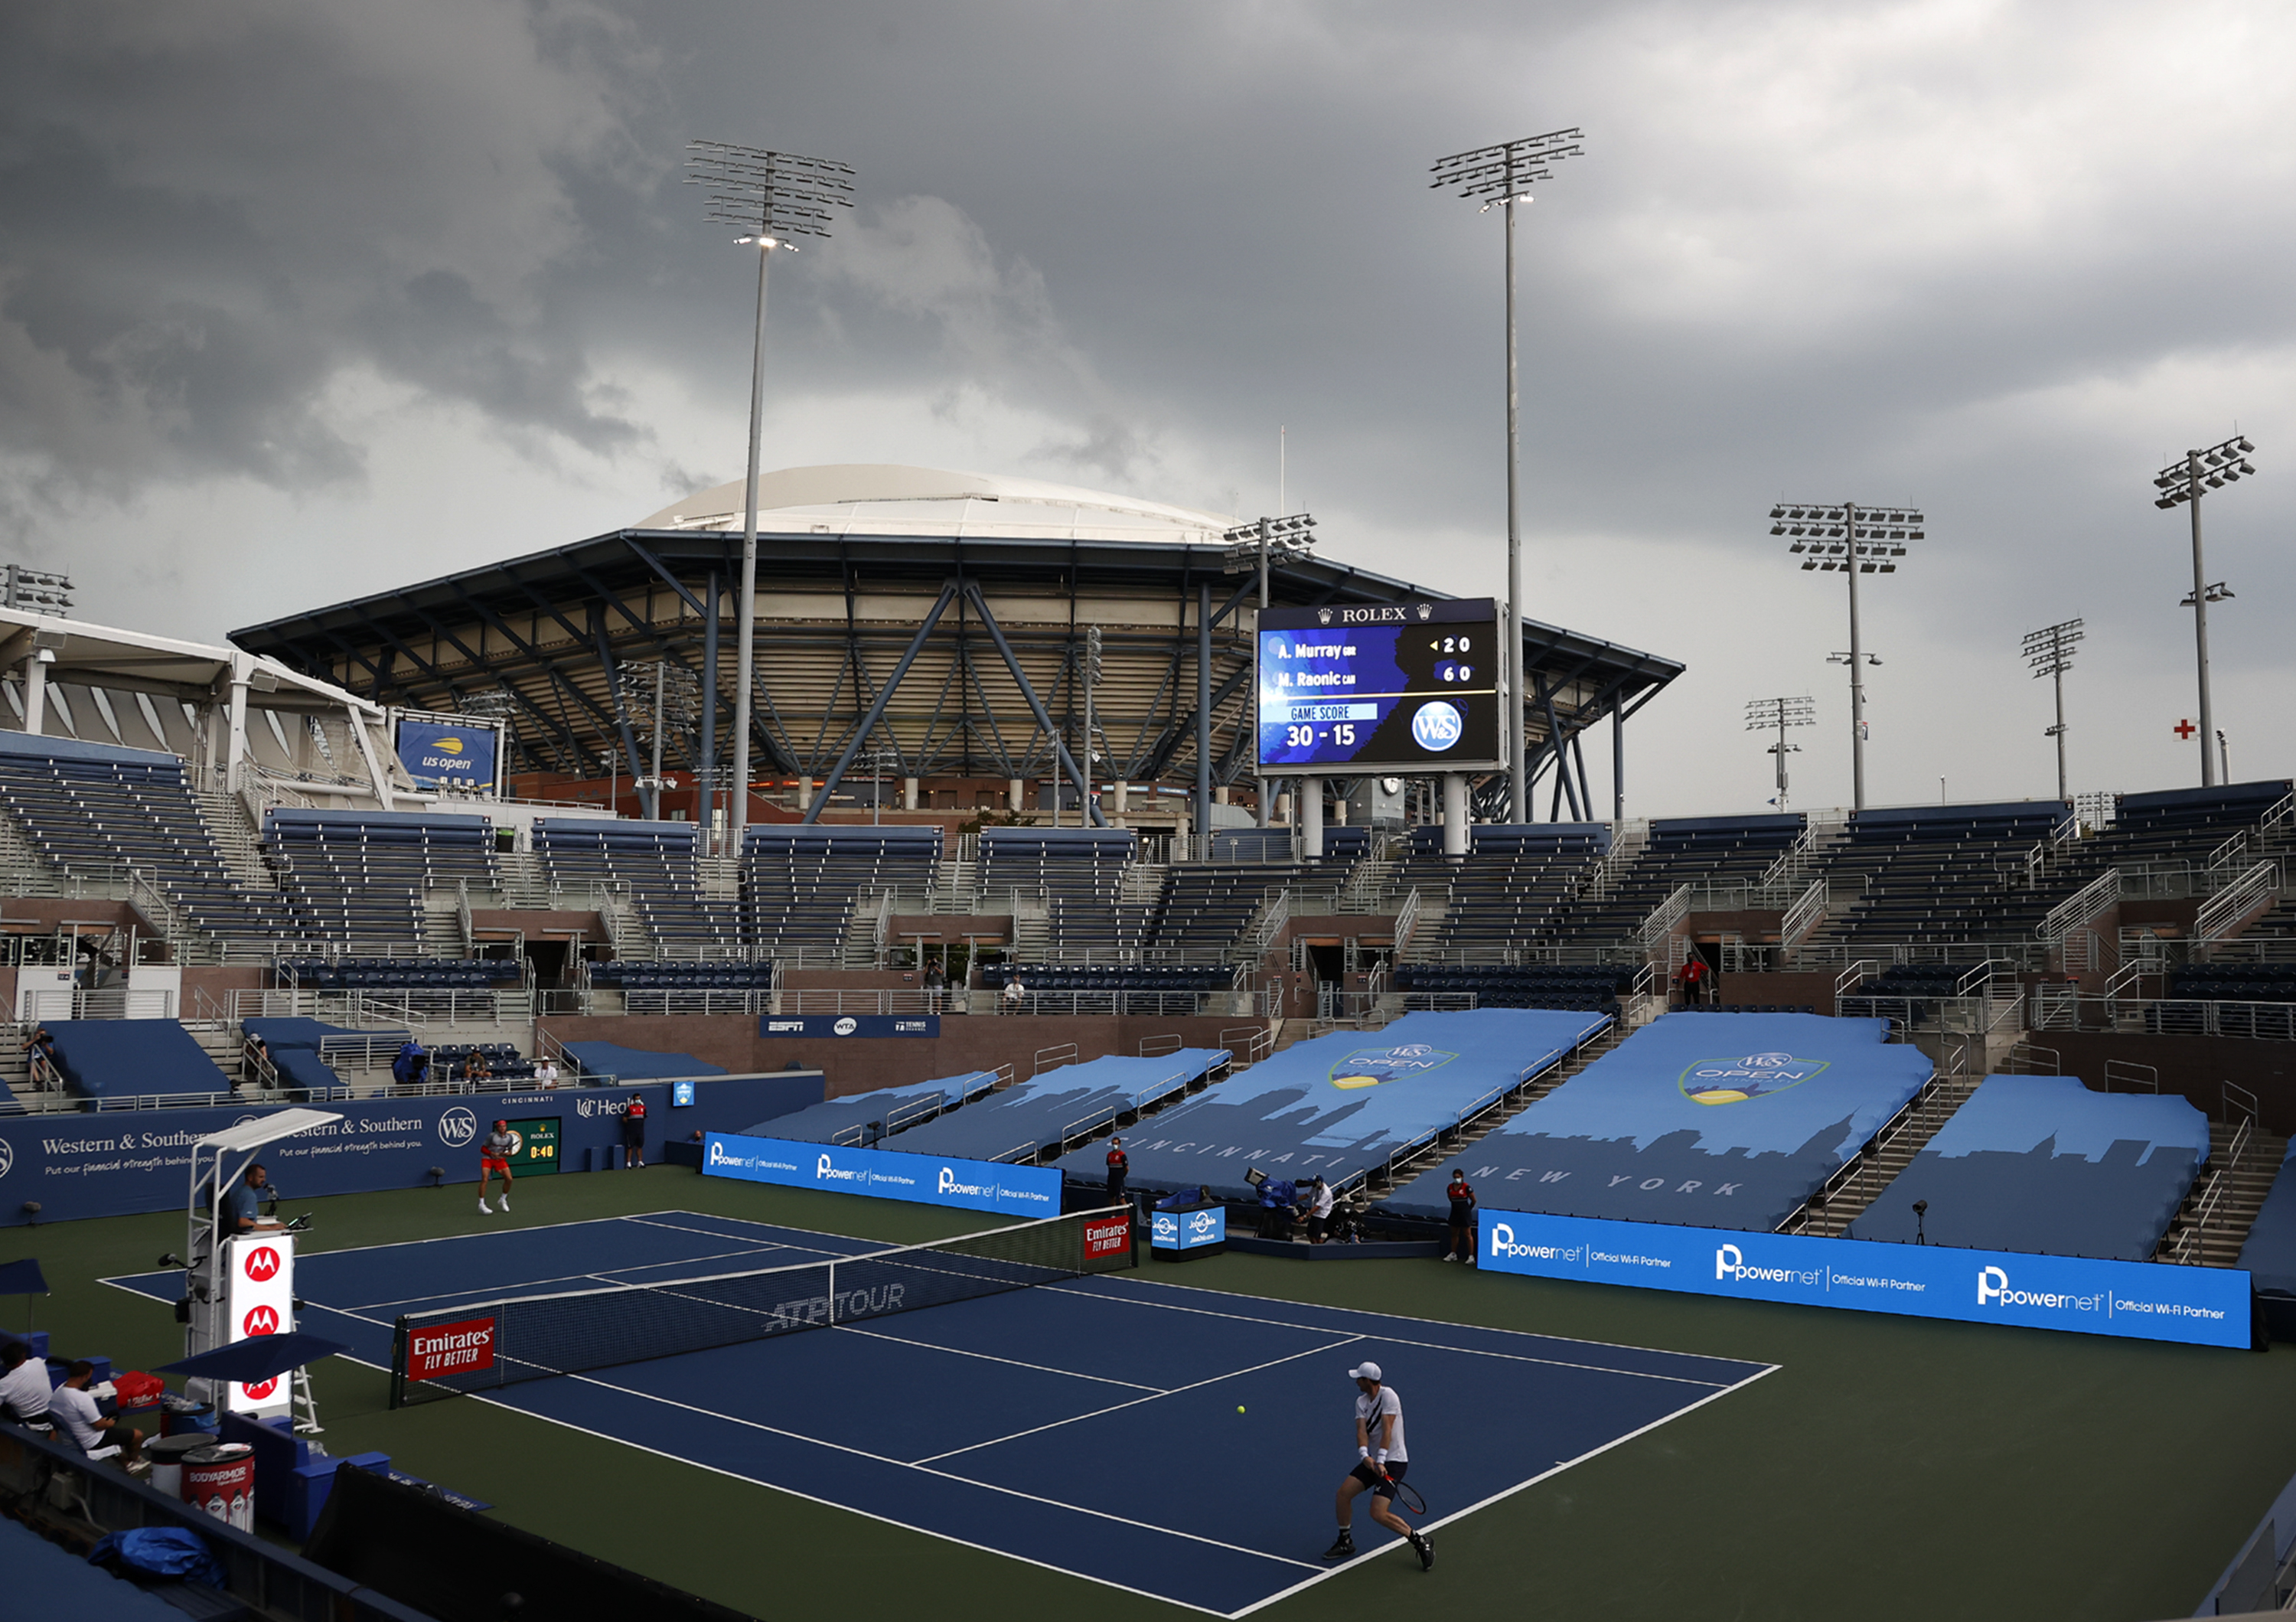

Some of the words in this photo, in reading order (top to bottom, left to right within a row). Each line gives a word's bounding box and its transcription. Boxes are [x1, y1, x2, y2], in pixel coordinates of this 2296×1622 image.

[1342, 608, 1407, 622] ROLEX
[1278, 645, 1292, 659] A.
[1295, 643, 1342, 660] Murray
[1443, 638, 1455, 653] 2
[1297, 671, 1342, 686] Raonic
[1443, 667, 1455, 682] 6
[1290, 707, 1316, 721] GAME
[1320, 706, 1350, 720] SCORE
[1287, 726, 1313, 746] 30
[1333, 724, 1356, 746] 15
[1417, 715, 1456, 740] W&S
[439, 758, 472, 771] open
[768, 1021, 804, 1031] ESPN
[1349, 1058, 1434, 1069] OPEN
[1695, 1069, 1805, 1079] OPEN
[502, 1096, 554, 1105] CINCINNATI
[598, 1096, 644, 1116] Heal
[285, 1123, 338, 1138] stern
[341, 1119, 355, 1134] &
[360, 1118, 422, 1133] Southern
[442, 1117, 473, 1138] W&S
[42, 1138, 115, 1154] Western
[119, 1134, 136, 1149] &
[142, 1130, 211, 1148] Southe
[311, 1144, 342, 1158] financial
[344, 1141, 378, 1155] strength
[380, 1141, 406, 1150] behind
[530, 1145, 553, 1158] 0:40
[1107, 1137, 1345, 1168] CINCINNATI
[45, 1165, 61, 1175] Put
[64, 1165, 80, 1173] our
[83, 1159, 120, 1176] financial
[123, 1156, 163, 1172] strength
[1471, 1166, 1572, 1183] NEW
[1607, 1175, 1743, 1196] YORK
[1000, 1189, 1017, 1198] Official
[1031, 1193, 1049, 1202] Partner
[1087, 1225, 1127, 1242] Emirates
[1093, 1241, 1102, 1252] FLY
[1103, 1237, 1121, 1251] BETTER
[1591, 1252, 1619, 1263] Official
[1621, 1255, 1639, 1265] Wi-Fi
[1641, 1256, 1671, 1268] Partner
[1832, 1274, 1864, 1287] Official
[1867, 1278, 1888, 1288] Wi-Fi
[1890, 1279, 1926, 1292] Partner
[761, 1296, 830, 1333] ATP
[835, 1283, 905, 1318] TOUR
[2115, 1300, 2154, 1314] Official
[2155, 1303, 2181, 1316] Wi-Fi
[2183, 1306, 2225, 1320] Partner
[414, 1329, 490, 1356] Emirates
[425, 1354, 442, 1370] FLY
[444, 1348, 478, 1367] BETTER
[190, 1466, 247, 1483] BODYARMOR
